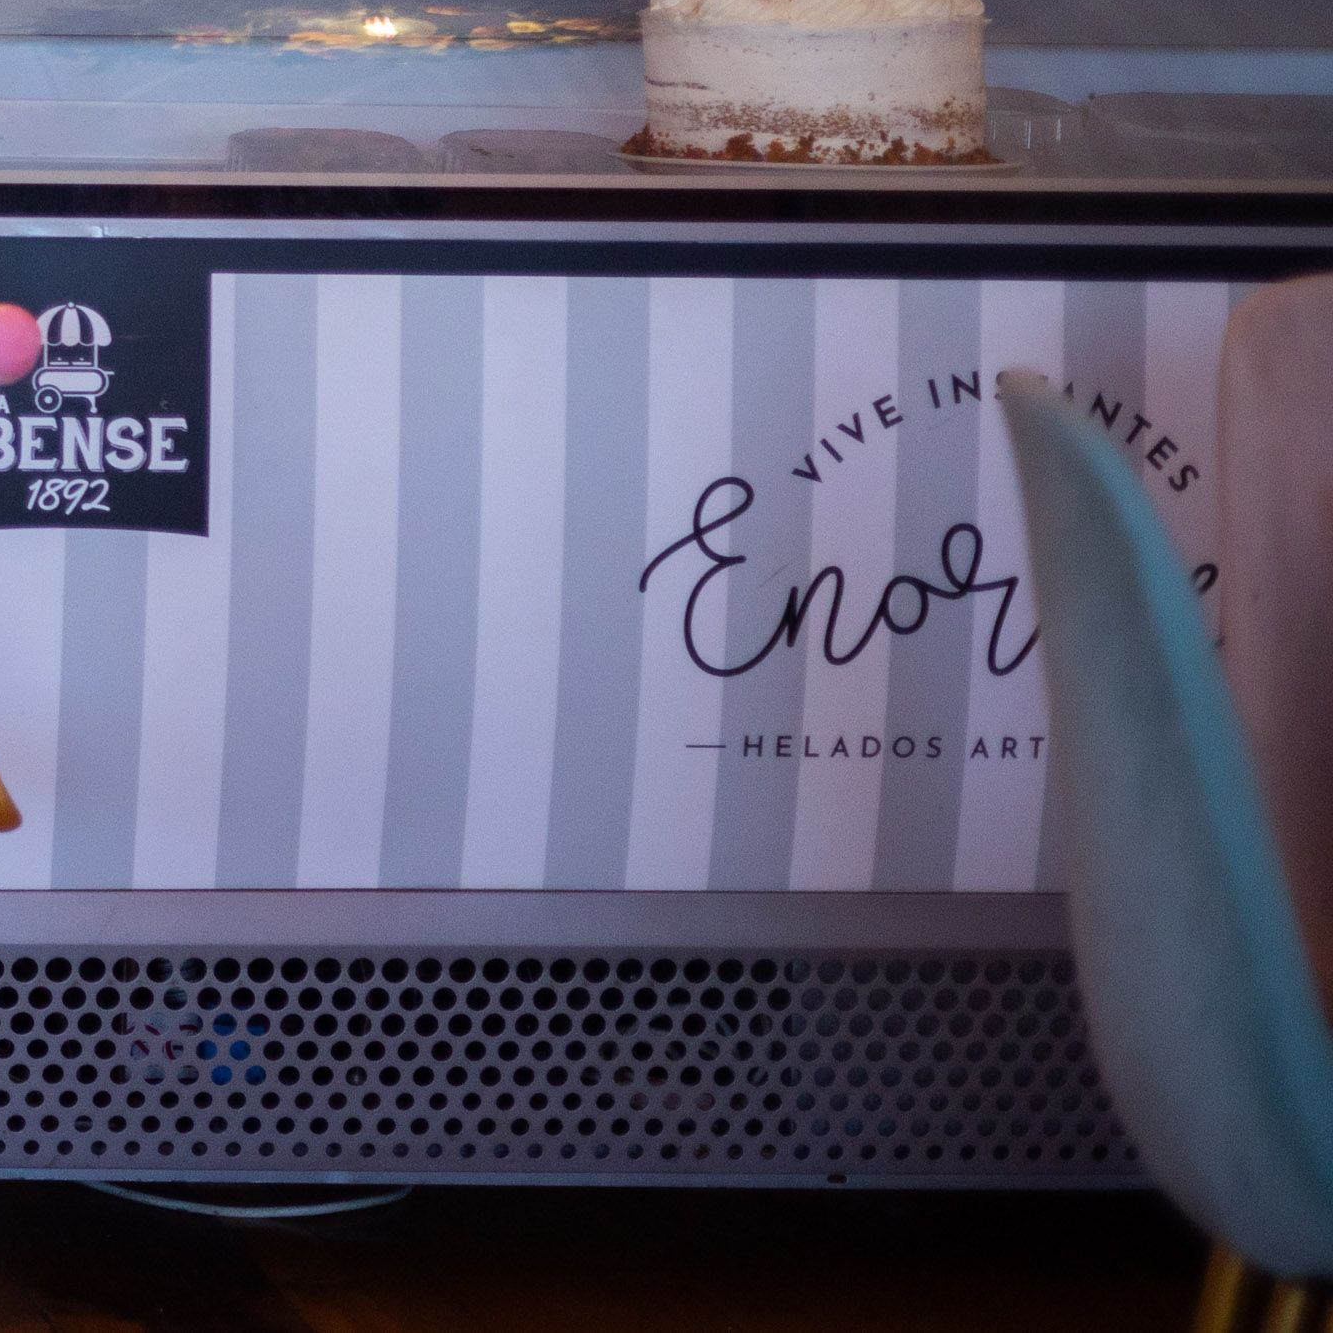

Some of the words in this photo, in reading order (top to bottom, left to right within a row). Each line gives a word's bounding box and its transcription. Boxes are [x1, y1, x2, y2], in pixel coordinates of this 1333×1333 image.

[791, 394, 904, 483] VIVE
[928, 370, 1200, 492] INNTES
[27, 478, 111, 515] 1892
[742, 735, 943, 759] HELADOS
